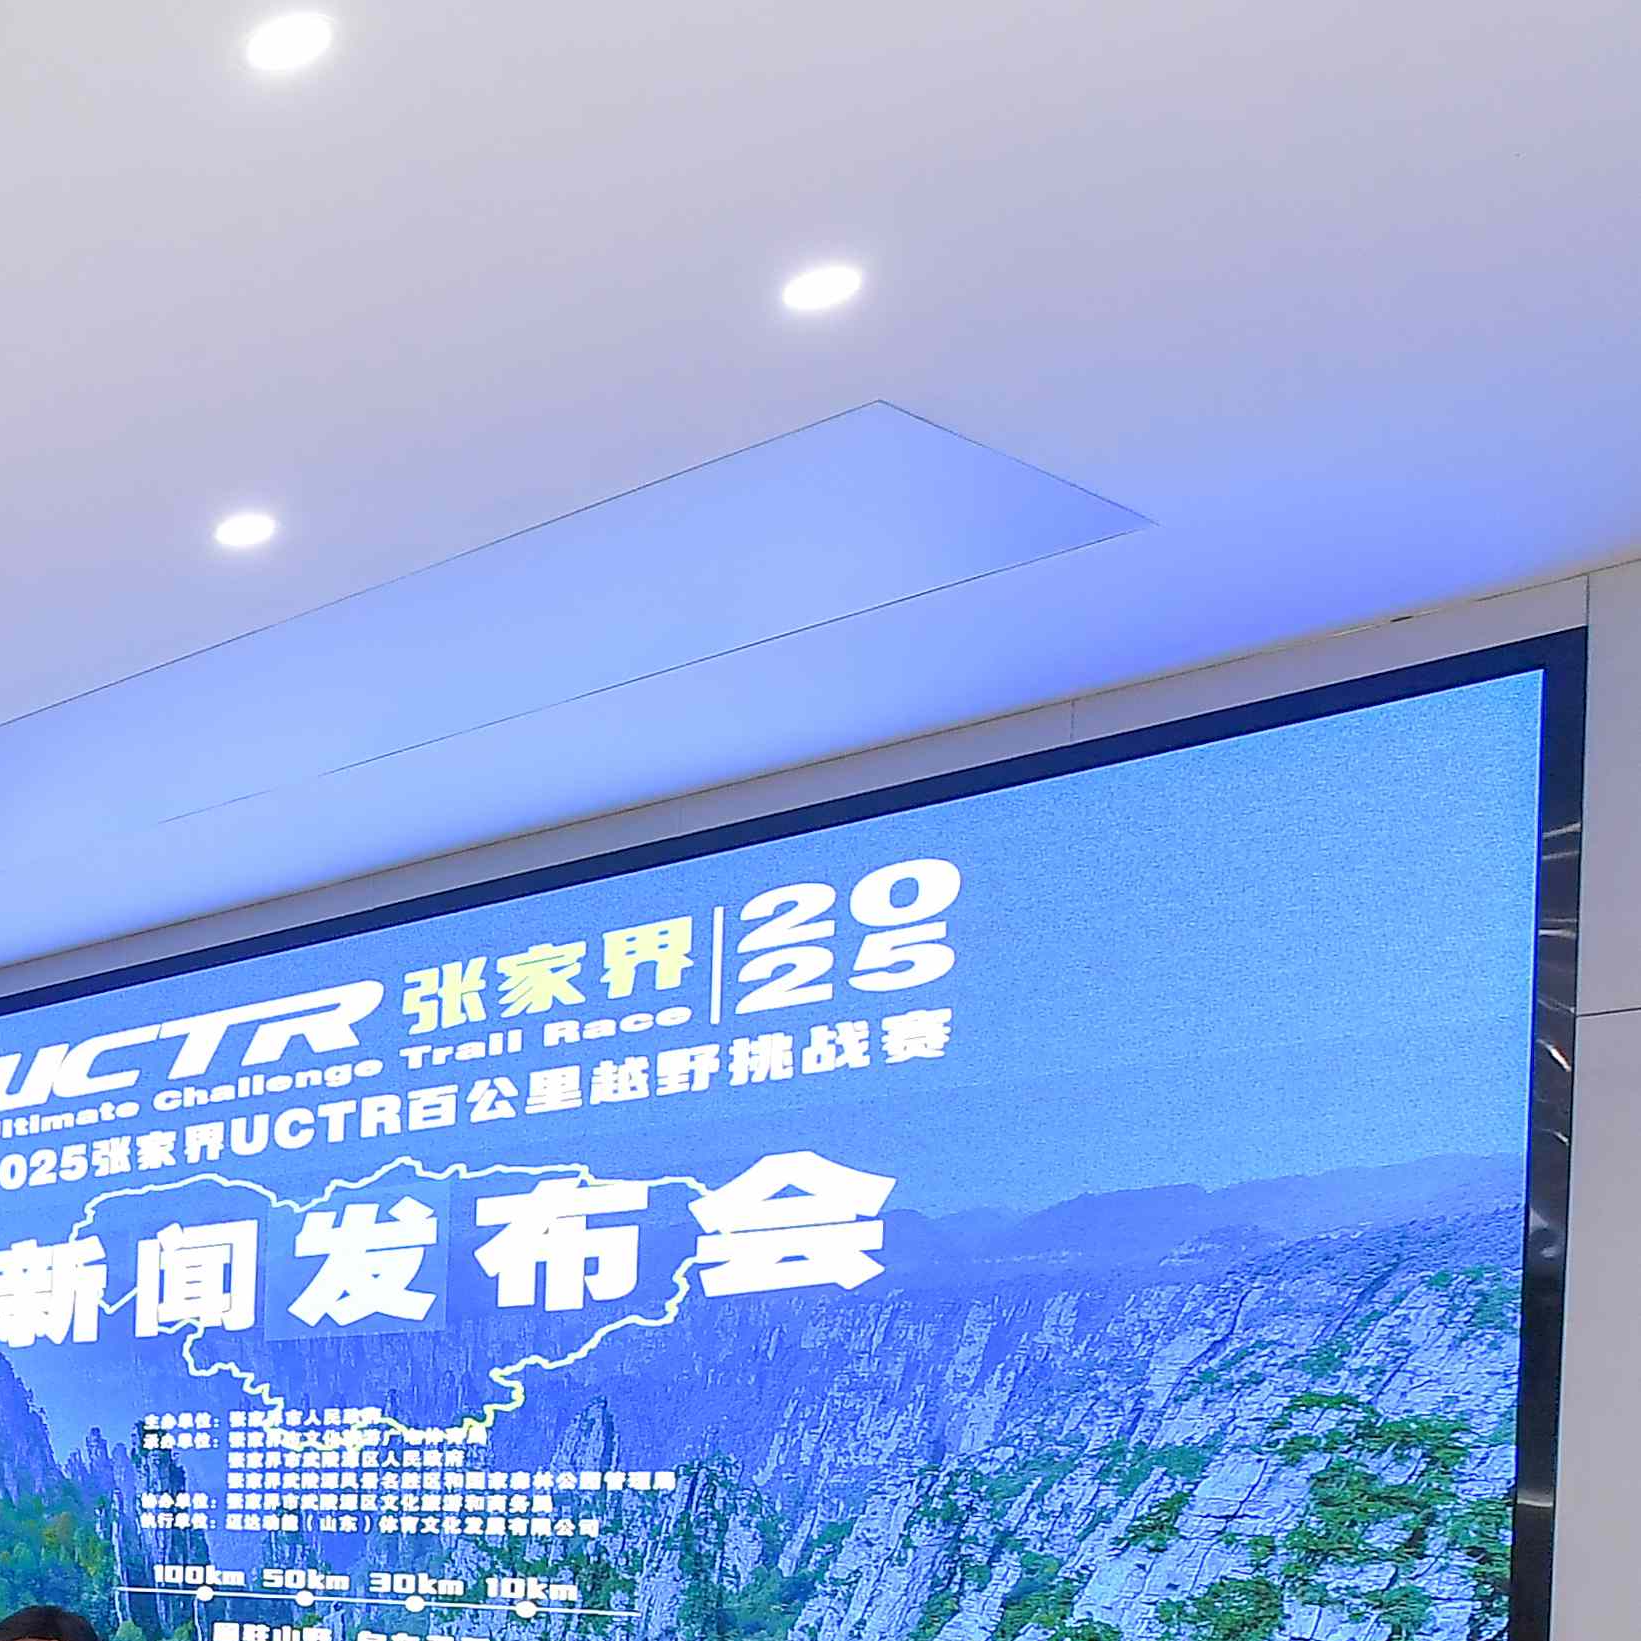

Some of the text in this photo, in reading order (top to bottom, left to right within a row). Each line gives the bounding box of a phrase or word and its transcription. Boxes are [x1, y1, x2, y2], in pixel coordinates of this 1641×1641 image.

[737, 857, 963, 951] 20
[402, 914, 695, 1035] 张家界
[734, 920, 957, 1016] 25
[152, 1056, 383, 1112] Challenge
[399, 1032, 523, 1069] Trail
[543, 1006, 692, 1050] Race
[152, 1563, 579, 1602] 100km 50km 30km 10km
